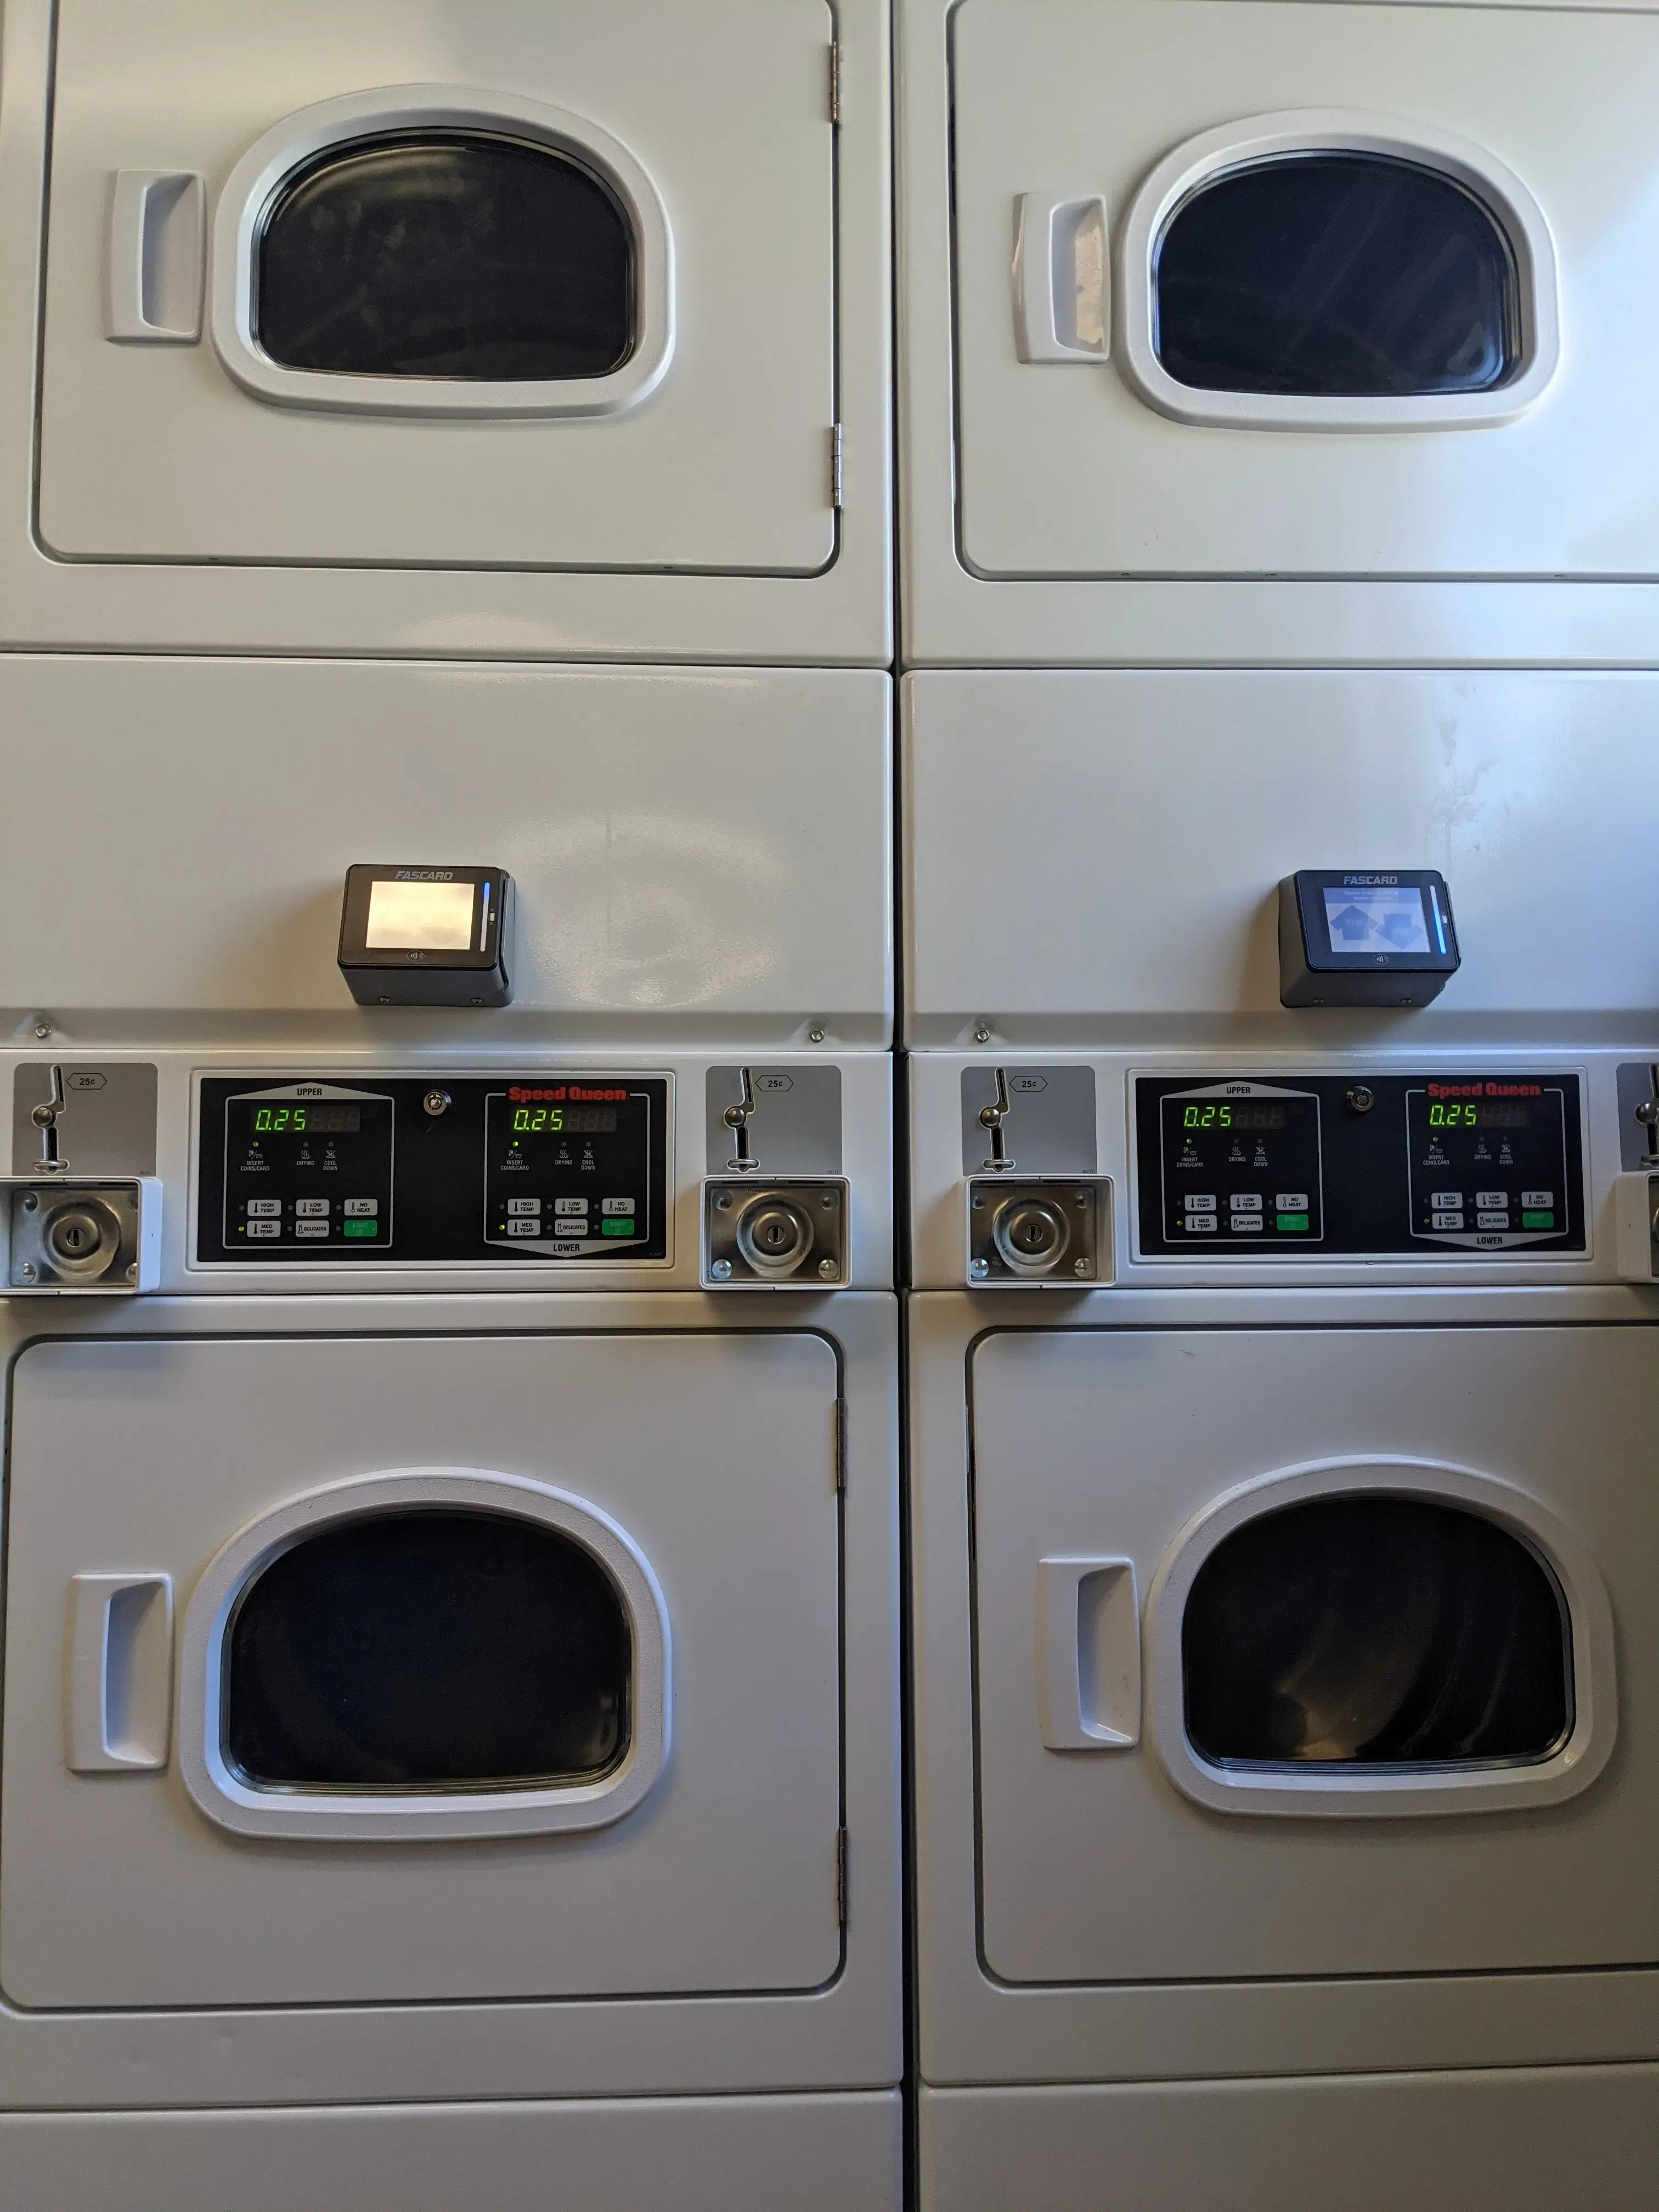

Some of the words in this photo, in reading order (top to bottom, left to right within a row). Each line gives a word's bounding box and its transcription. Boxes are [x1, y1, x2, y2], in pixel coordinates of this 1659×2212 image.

[395, 871, 453, 881] FASCARD
[1344, 876, 1398, 884] FASCARD
[509, 1087, 566, 1103] Speed
[569, 1086, 627, 1101] Queen
[1428, 1083, 1482, 1099] Speed
[1485, 1082, 1541, 1096] Queen
[255, 1110, 306, 1130] 0.25
[514, 1110, 563, 1130] 0.25
[1184, 1107, 1231, 1127] 0.25
[1430, 1105, 1476, 1125] 0.25
